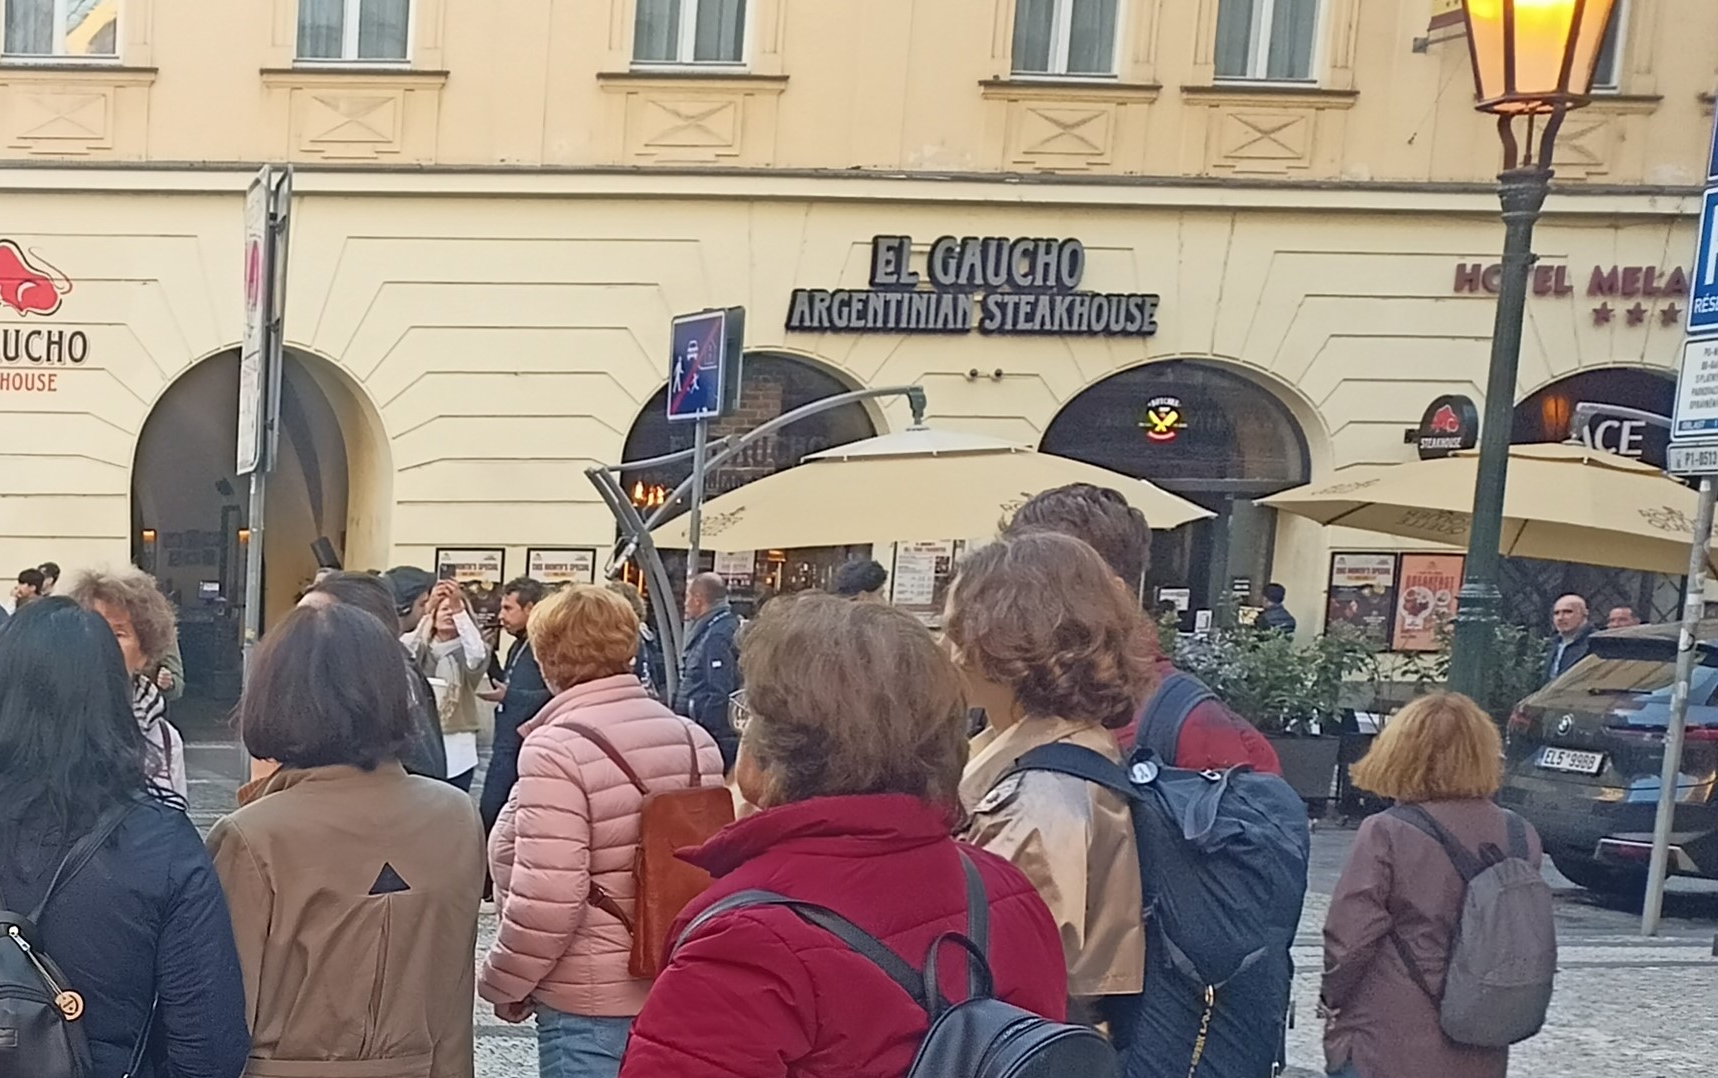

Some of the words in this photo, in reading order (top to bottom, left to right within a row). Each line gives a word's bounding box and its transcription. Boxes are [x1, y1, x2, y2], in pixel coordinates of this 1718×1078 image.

[872, 237, 920, 286] EL
[930, 237, 1084, 288] GAUCHO
[1453, 263, 1573, 295] HOEL
[787, 290, 974, 330] ARGENTINIAN
[982, 294, 1160, 334] STEAKHOUSE
[1420, 437, 1461, 449] STEAKHOUSE
